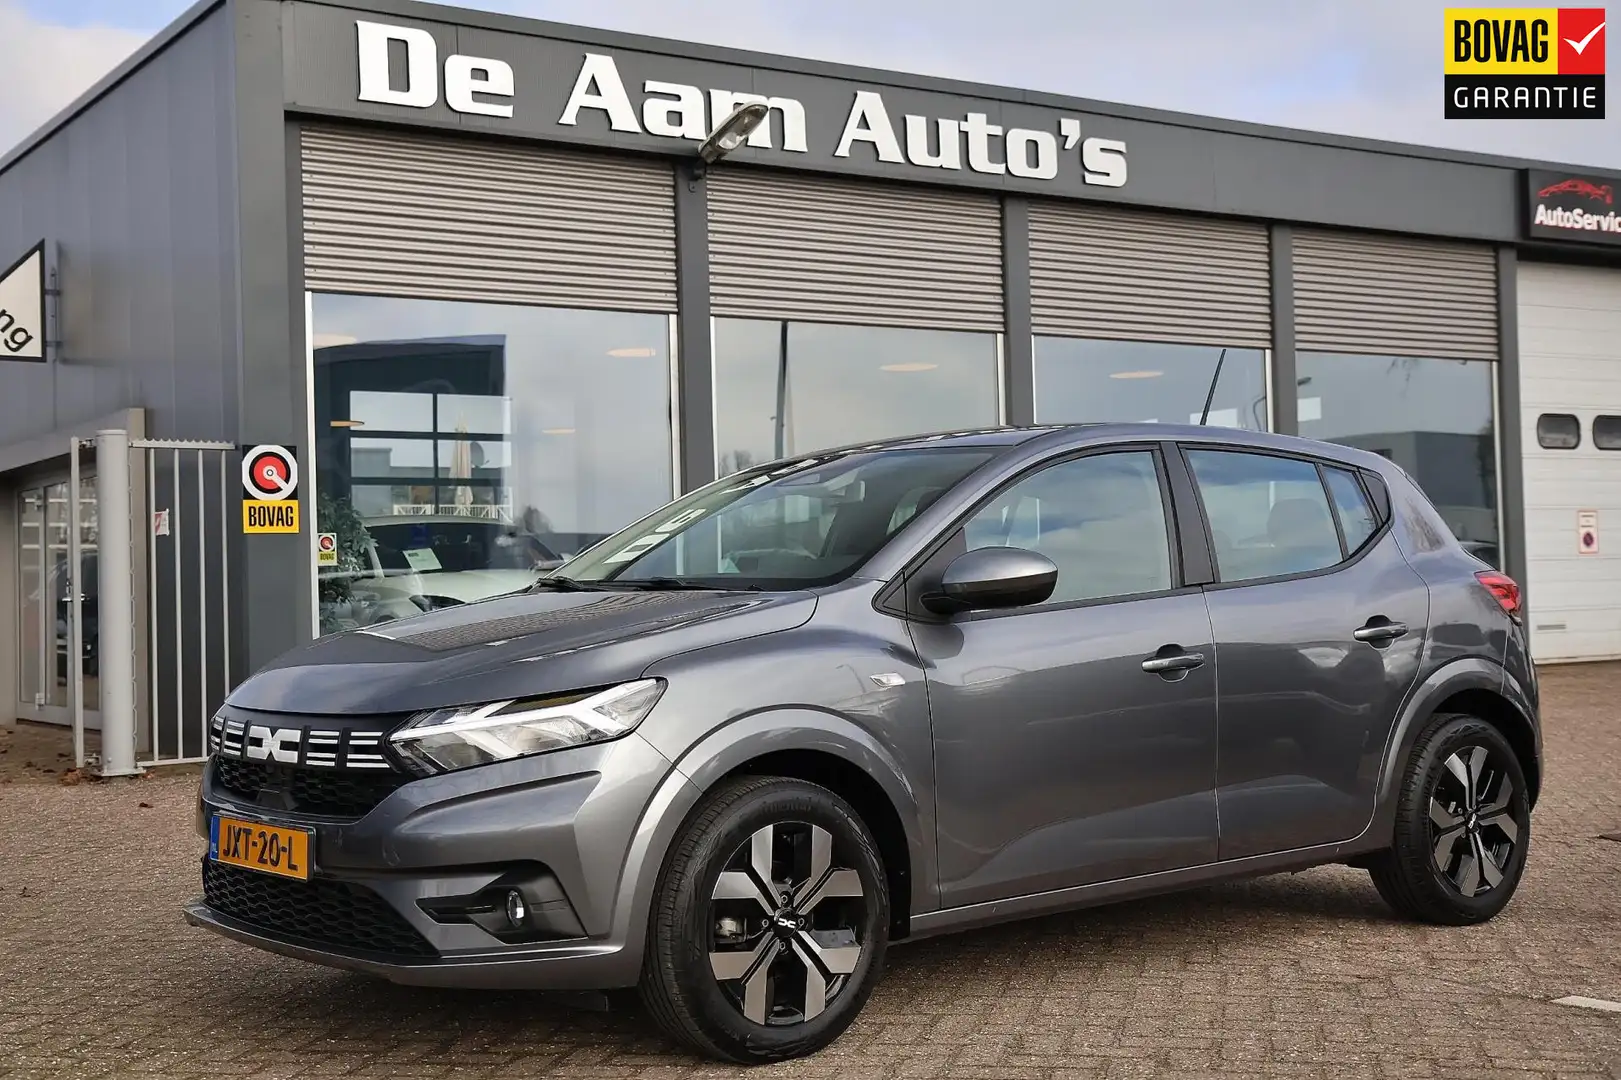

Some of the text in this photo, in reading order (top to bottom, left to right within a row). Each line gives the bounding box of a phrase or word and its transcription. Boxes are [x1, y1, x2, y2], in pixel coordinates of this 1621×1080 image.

[355, 20, 1128, 188] De Aam Auto's
[248, 505, 294, 528] BOVAG
[222, 823, 299, 872] JXT-20-L
